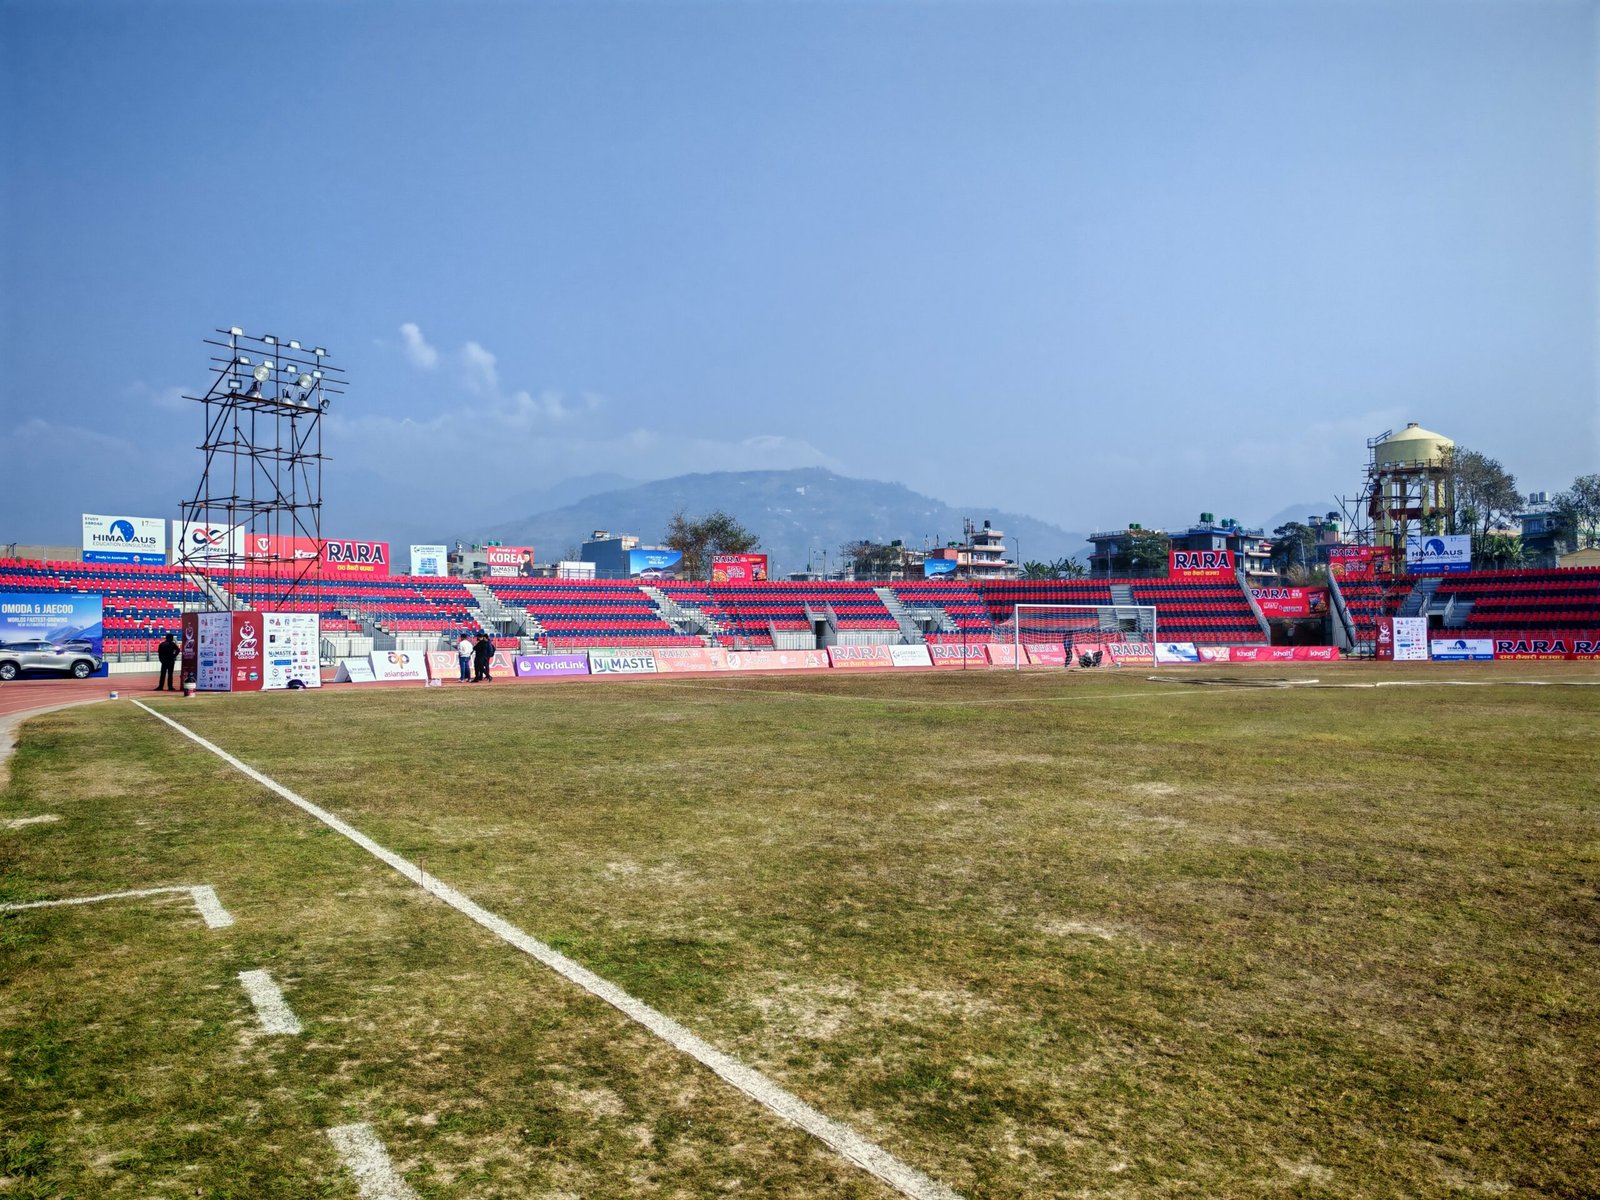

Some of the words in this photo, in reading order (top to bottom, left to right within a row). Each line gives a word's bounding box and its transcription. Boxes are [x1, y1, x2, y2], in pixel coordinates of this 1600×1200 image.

[326, 542, 386, 564] RARA
[489, 553, 523, 563] KOREA
[1330, 549, 1360, 557] RARA
[1173, 551, 1232, 570] RARA
[1250, 589, 1291, 599] RARA
[2, 604, 32, 614] OMODA
[35, 604, 41, 614] &
[42, 604, 74, 614] JAECOO
[932, 644, 984, 658] RARA
[1110, 644, 1154, 656] RARA
[1495, 640, 1568, 653] RARA
[614, 648, 653, 657] JAPAN
[659, 650, 692, 658] RARA
[830, 646, 886, 660] RARA
[1236, 649, 1258, 657] khalti
[1272, 649, 1294, 657] khalti
[1309, 649, 1332, 657] khalti
[533, 661, 585, 671] WorldLink
[593, 658, 654, 671] NAMASTE
[383, 669, 420, 679] asianpaints
